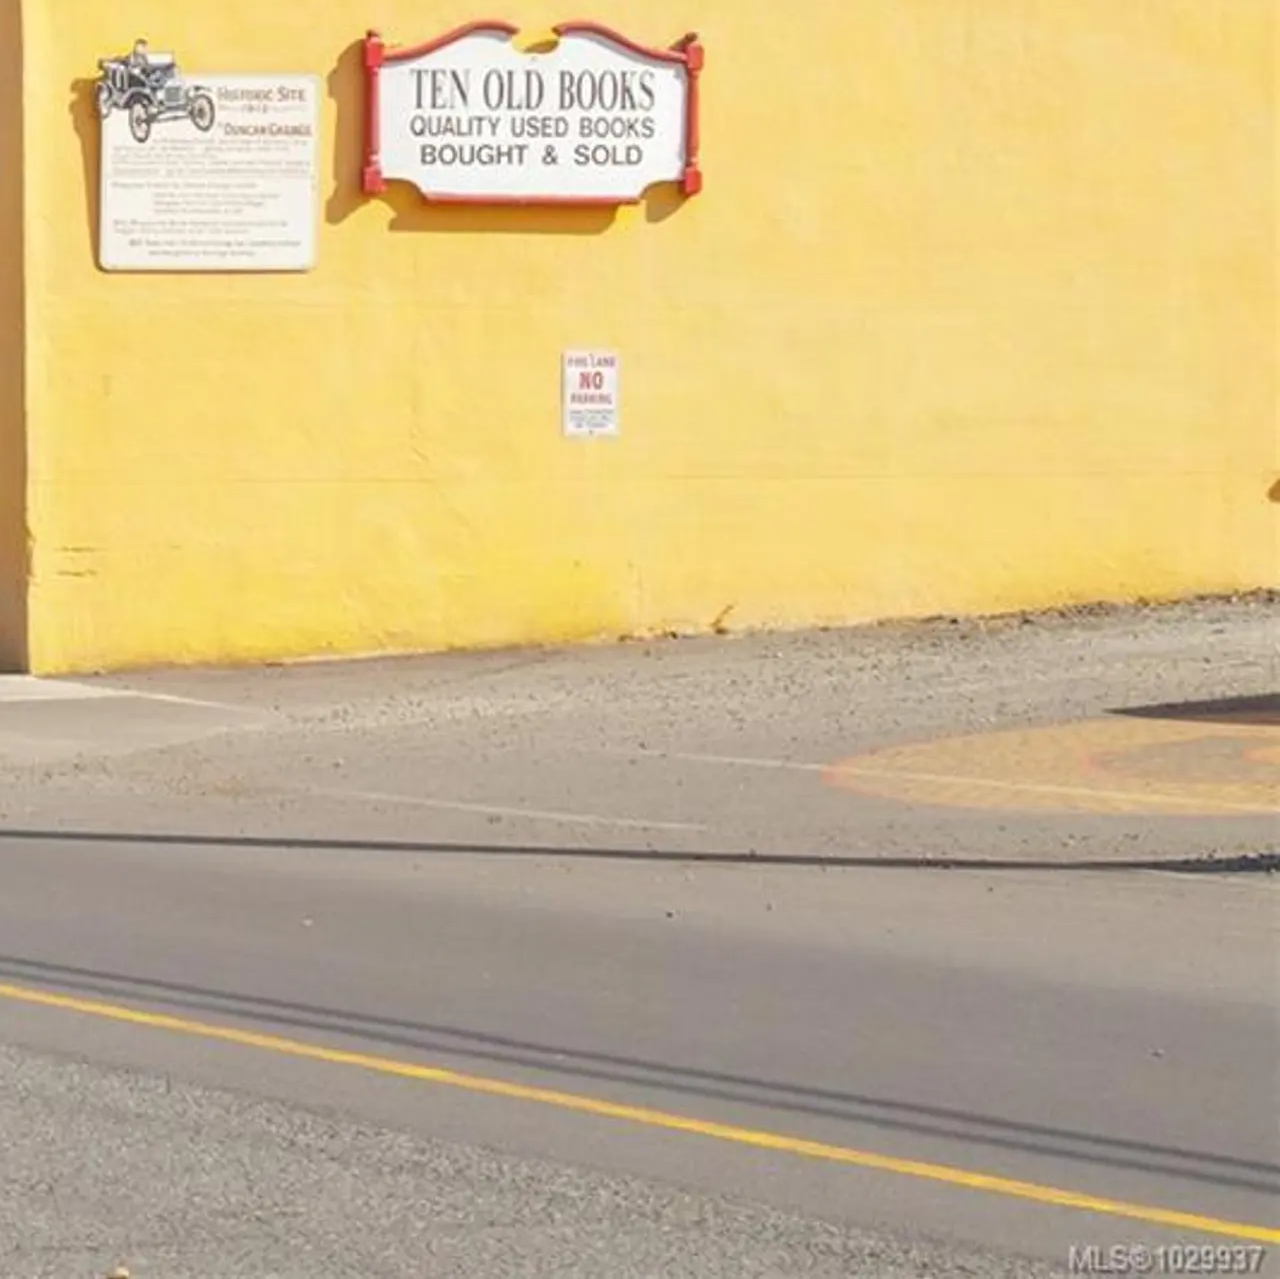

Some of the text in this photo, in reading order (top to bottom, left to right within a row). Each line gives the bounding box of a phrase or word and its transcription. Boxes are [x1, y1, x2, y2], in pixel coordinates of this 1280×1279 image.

[410, 69, 655, 111] TEN OLD BOOKS
[409, 115, 655, 139] QUALITY USED BOOKS
[420, 144, 643, 166] BOUGHT & SOLD
[578, 370, 604, 390] NO
